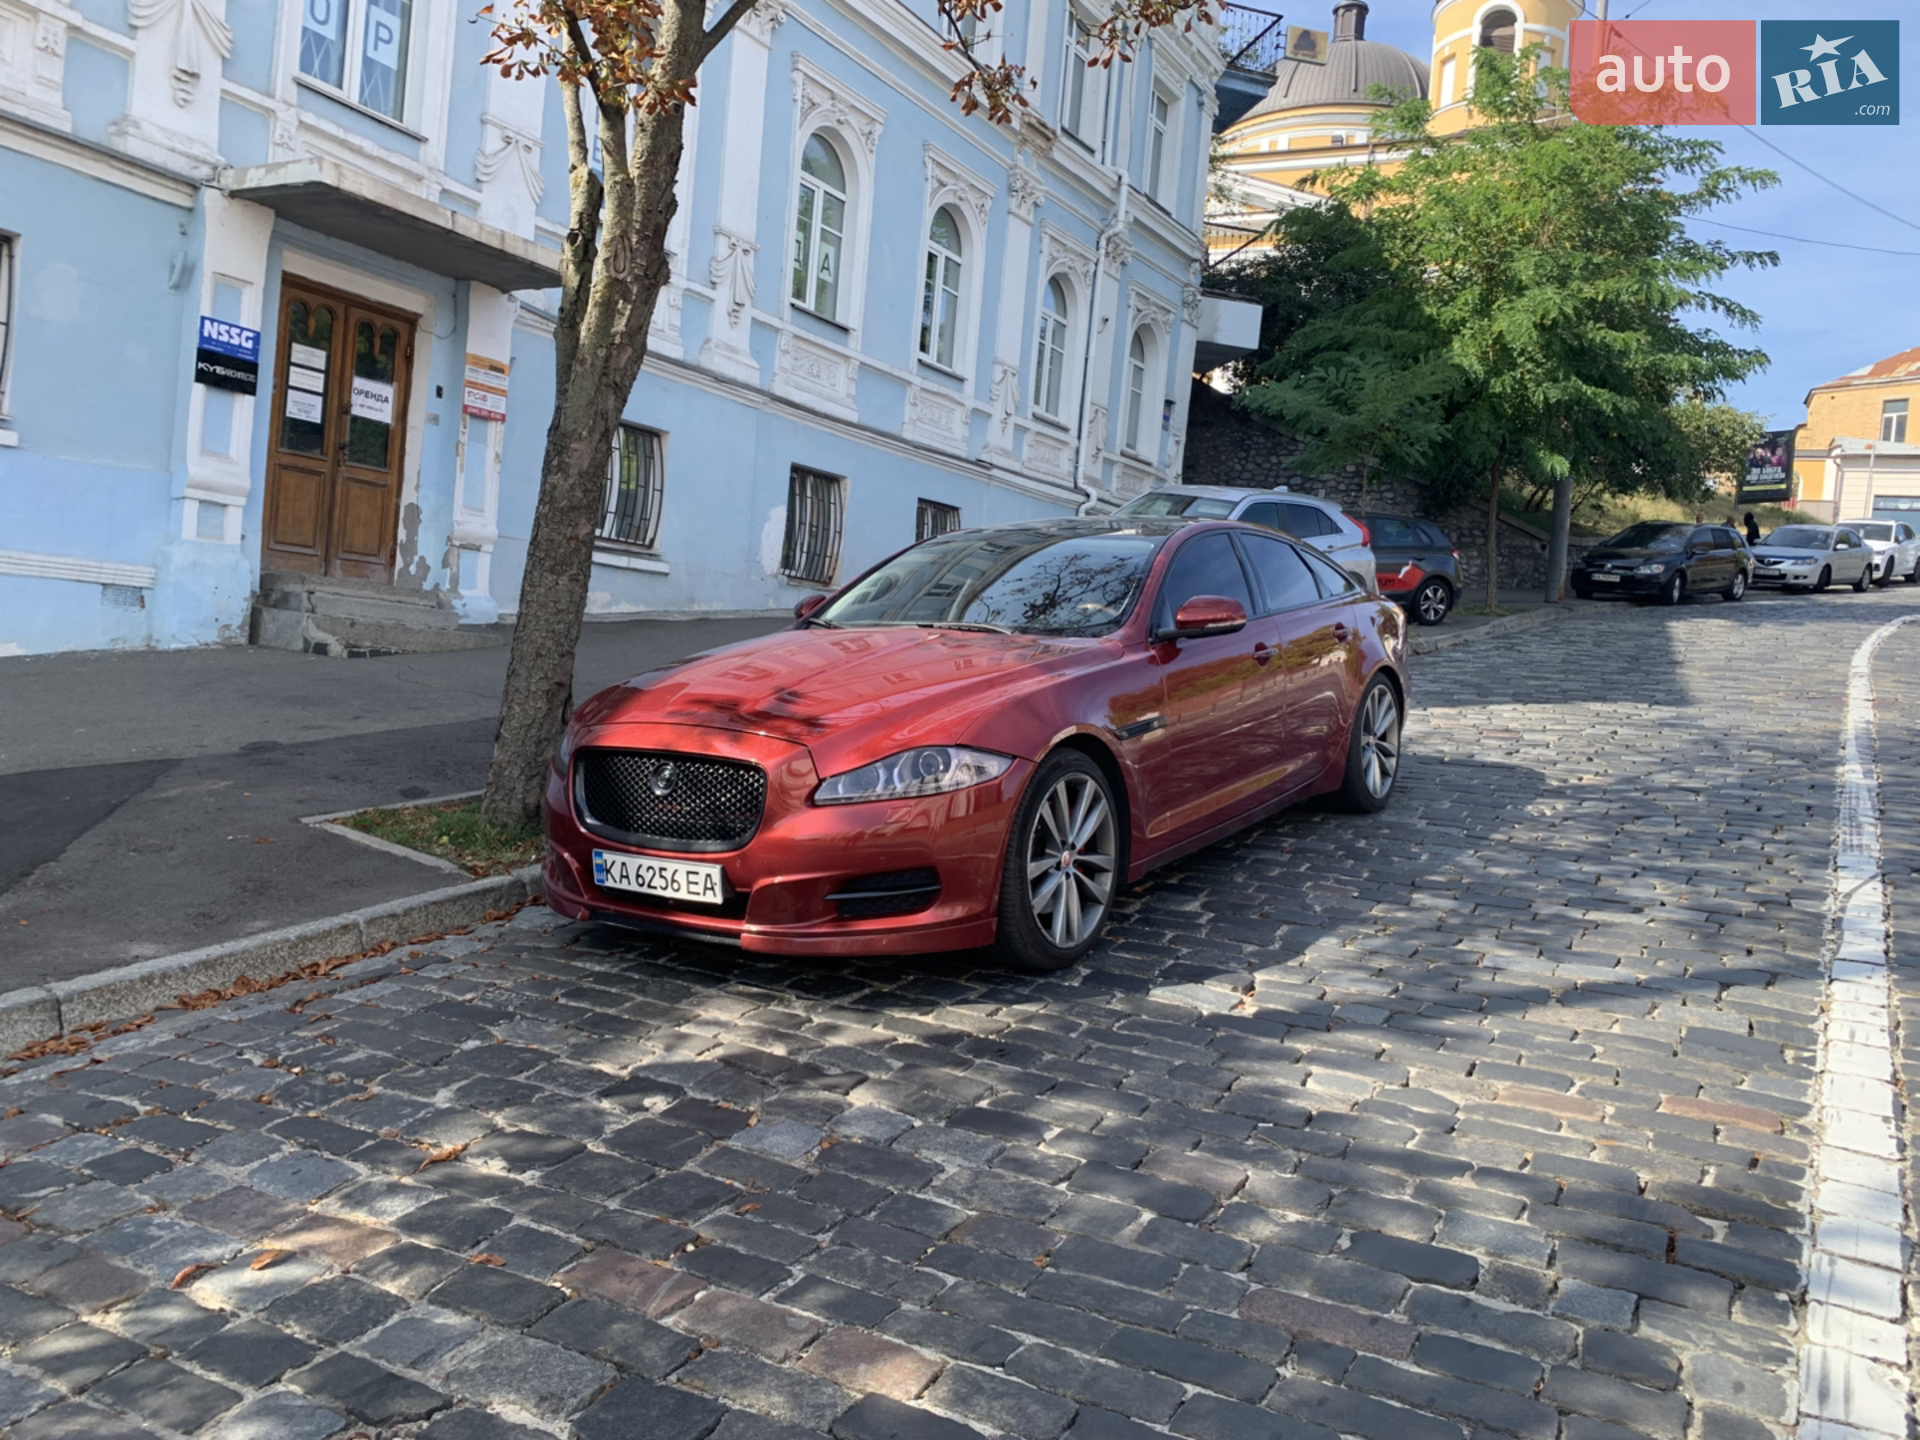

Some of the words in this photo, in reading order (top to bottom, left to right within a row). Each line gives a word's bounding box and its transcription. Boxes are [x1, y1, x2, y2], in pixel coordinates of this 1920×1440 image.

[203, 318, 255, 350] NSSG
[353, 387, 389, 404] ОРЕНДА
[604, 859, 632, 886] KA
[635, 864, 682, 893] 6256
[686, 870, 717, 898] EA
